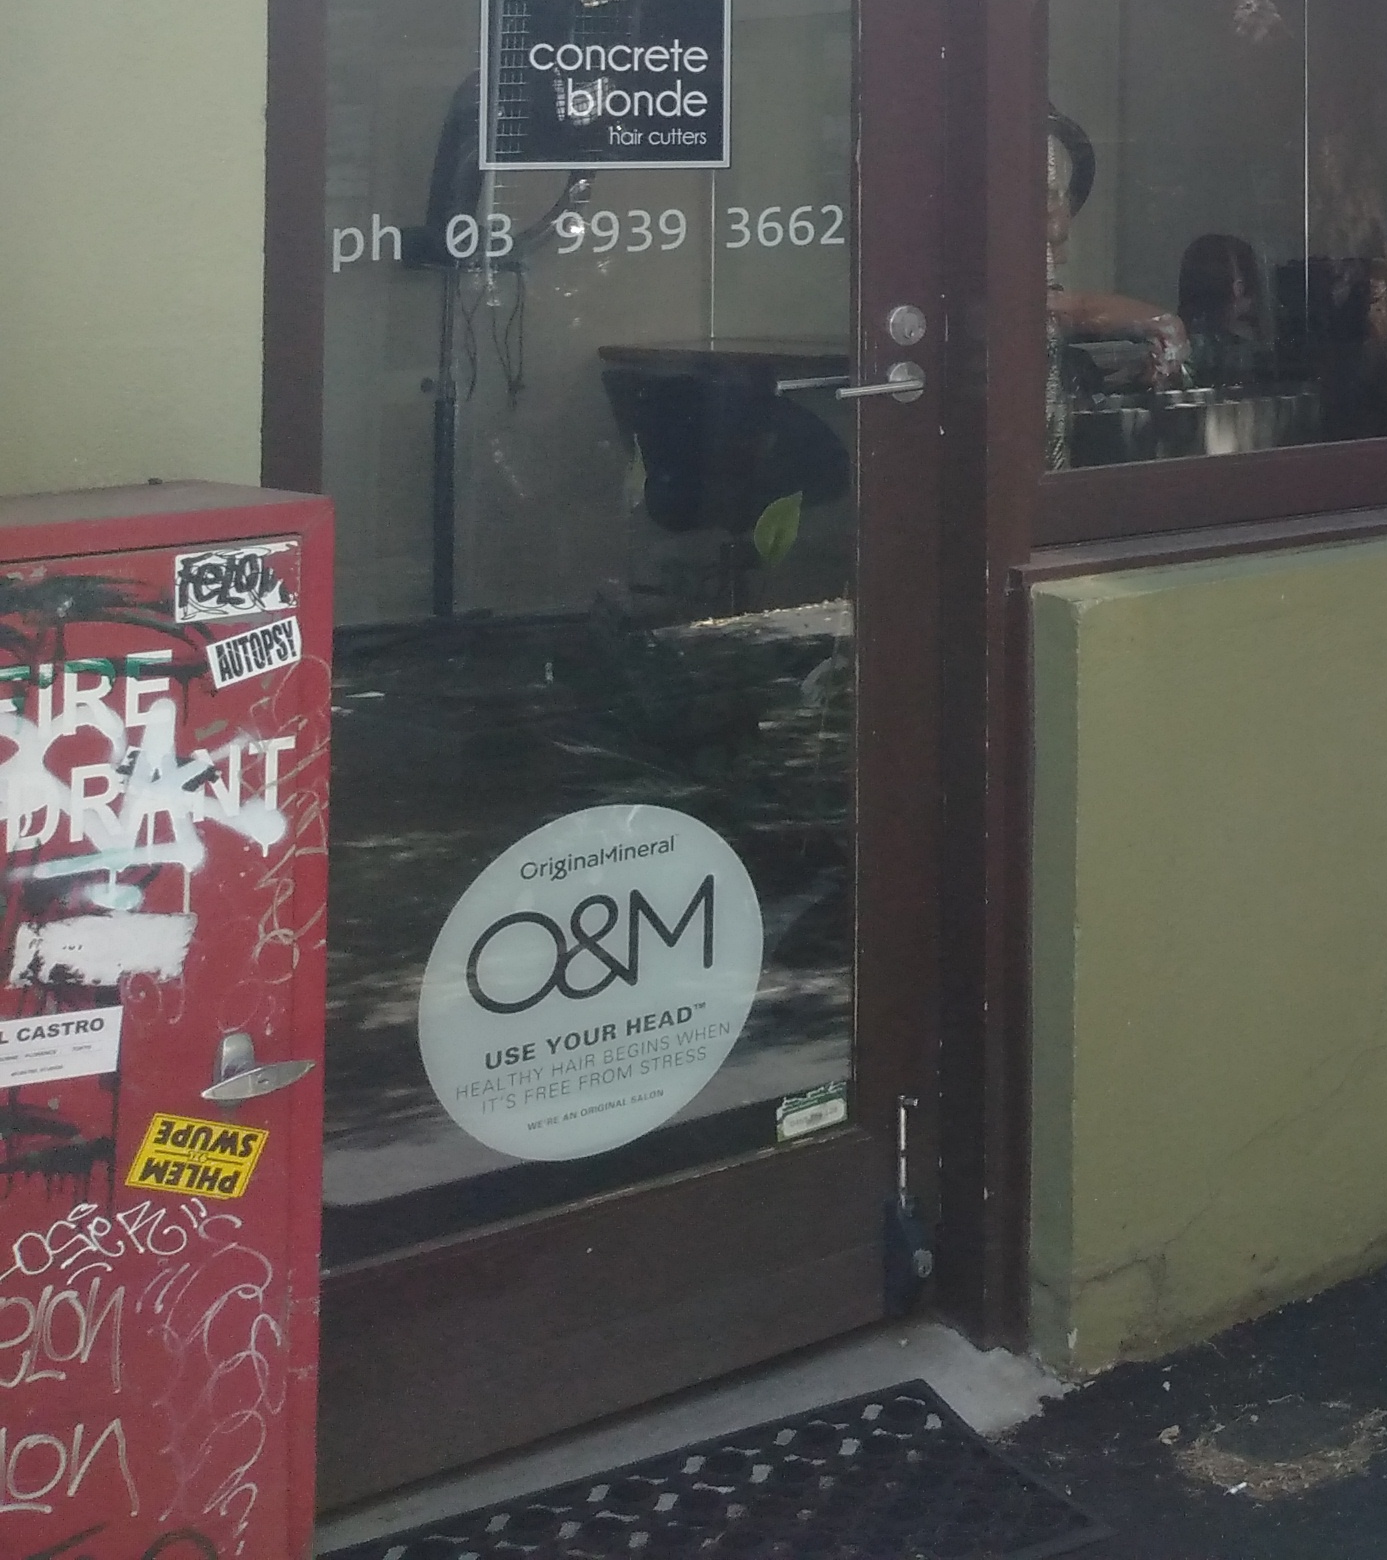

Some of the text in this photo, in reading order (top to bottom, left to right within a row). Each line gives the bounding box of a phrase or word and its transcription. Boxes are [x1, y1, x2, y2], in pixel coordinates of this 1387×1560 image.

[528, 39, 709, 72] concrete
[567, 77, 708, 117] blonde
[608, 126, 707, 145] hair cutters
[331, 204, 846, 272] ph 03 9939 3662
[215, 620, 298, 683] AUTOPSY
[520, 834, 676, 882] OriginalMineral
[465, 874, 714, 1015] O&M
[16, 1017, 105, 1042] CASTRO
[484, 1042, 536, 1070] USE
[546, 1023, 617, 1056] YOUR
[455, 1021, 731, 1101] HEALTHY HAIR BEGINS WHEN
[481, 1046, 708, 1115] IT'S FREE FROM STRESS
[153, 1119, 259, 1158] SWUPE
[138, 1157, 242, 1194] PHLEM
